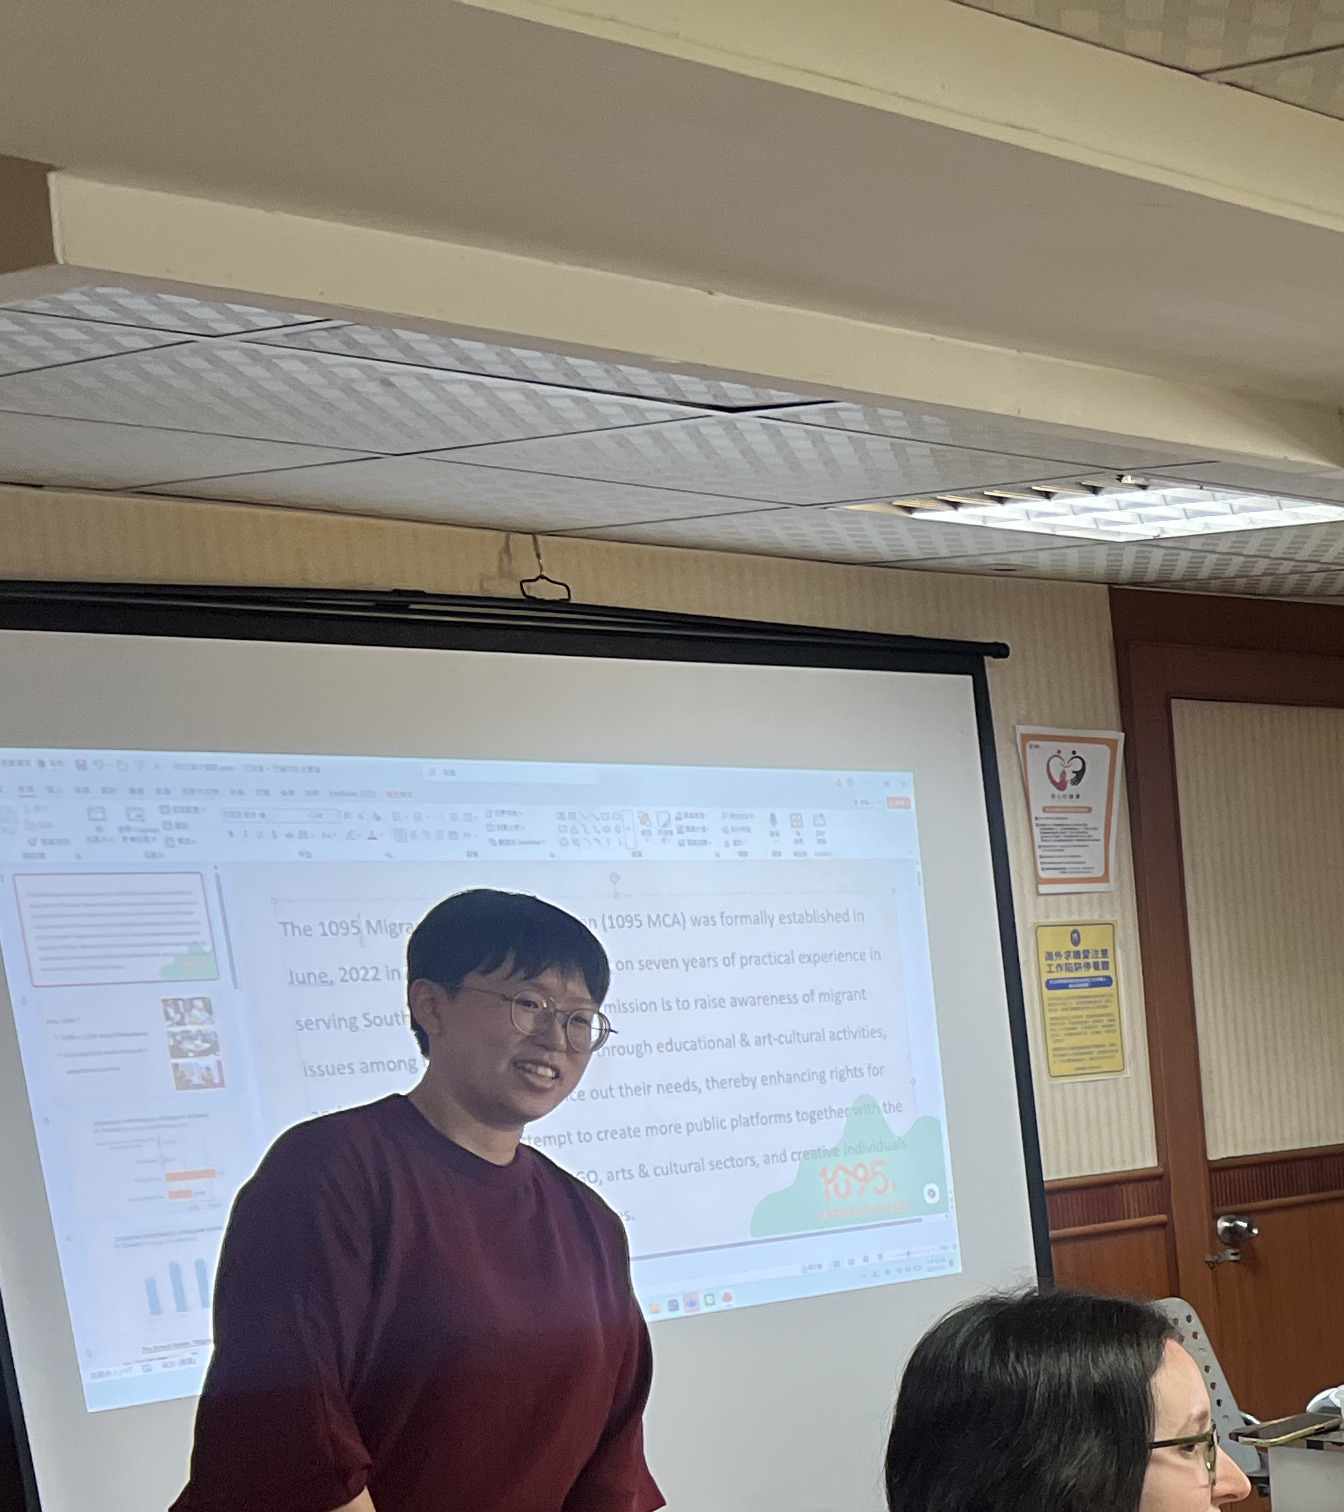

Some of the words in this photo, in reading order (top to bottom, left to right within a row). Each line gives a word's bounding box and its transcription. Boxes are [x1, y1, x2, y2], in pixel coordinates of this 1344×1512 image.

[279, 921, 313, 938] The
[318, 919, 361, 937] 1095
[366, 919, 415, 940] Migra
[602, 912, 643, 932] (1095
[647, 911, 686, 930] MCA)
[690, 914, 717, 927] was
[720, 910, 775, 928] formally
[778, 907, 850, 925] established
[853, 908, 865, 923] in
[287, 968, 334, 986] June,
[338, 966, 382, 983] 2022
[385, 964, 401, 981] in
[615, 959, 634, 972] on
[638, 957, 679, 971] seven
[682, 955, 719, 972] years
[722, 952, 737, 967] of
[740, 949, 795, 970] practical
[798, 949, 866, 966] experience
[869, 947, 882, 961] in
[295, 1013, 360, 1032] serving
[363, 1011, 411, 1028] South
[603, 999, 658, 1015] mission
[661, 996, 672, 1012] is
[676, 998, 691, 1011] to
[694, 995, 726, 1010] raise
[729, 992, 799, 1009] awareness
[802, 988, 815, 1004] of
[818, 988, 868, 1005] migrant
[303, 1062, 355, 1078] issues
[359, 1057, 419, 1075] among
[656, 1034, 736, 1053] educational
[740, 1032, 751, 1047] &
[754, 1027, 826, 1047] art-cultural
[829, 1025, 887, 1041] activities,
[590, 1085, 615, 1100] out
[618, 1081, 651, 1098] their
[656, 1077, 702, 1095] needs,
[705, 1071, 758, 1091] thereby
[761, 1067, 827, 1086] enhancing
[830, 1064, 864, 1084] rights
[867, 1062, 886, 1078] for
[526, 1131, 573, 1149] tempt
[577, 1130, 593, 1143] to
[596, 1126, 641, 1141] create
[645, 1122, 682, 1136] more
[686, 1115, 728, 1136] public
[730, 1112, 793, 1132] platforms
[795, 1105, 849, 1125] together
[850, 1101, 881, 1116] with
[883, 1100, 903, 1114] the
[575, 1169, 603, 1186] GO,
[606, 1167, 634, 1182] arts
[638, 1163, 649, 1179] &
[653, 1157, 706, 1177] cultural
[709, 1153, 760, 1171] sectors,
[763, 1150, 787, 1165] and
[791, 1145, 840, 1163] creative
[843, 1137, 907, 1155] individuals
